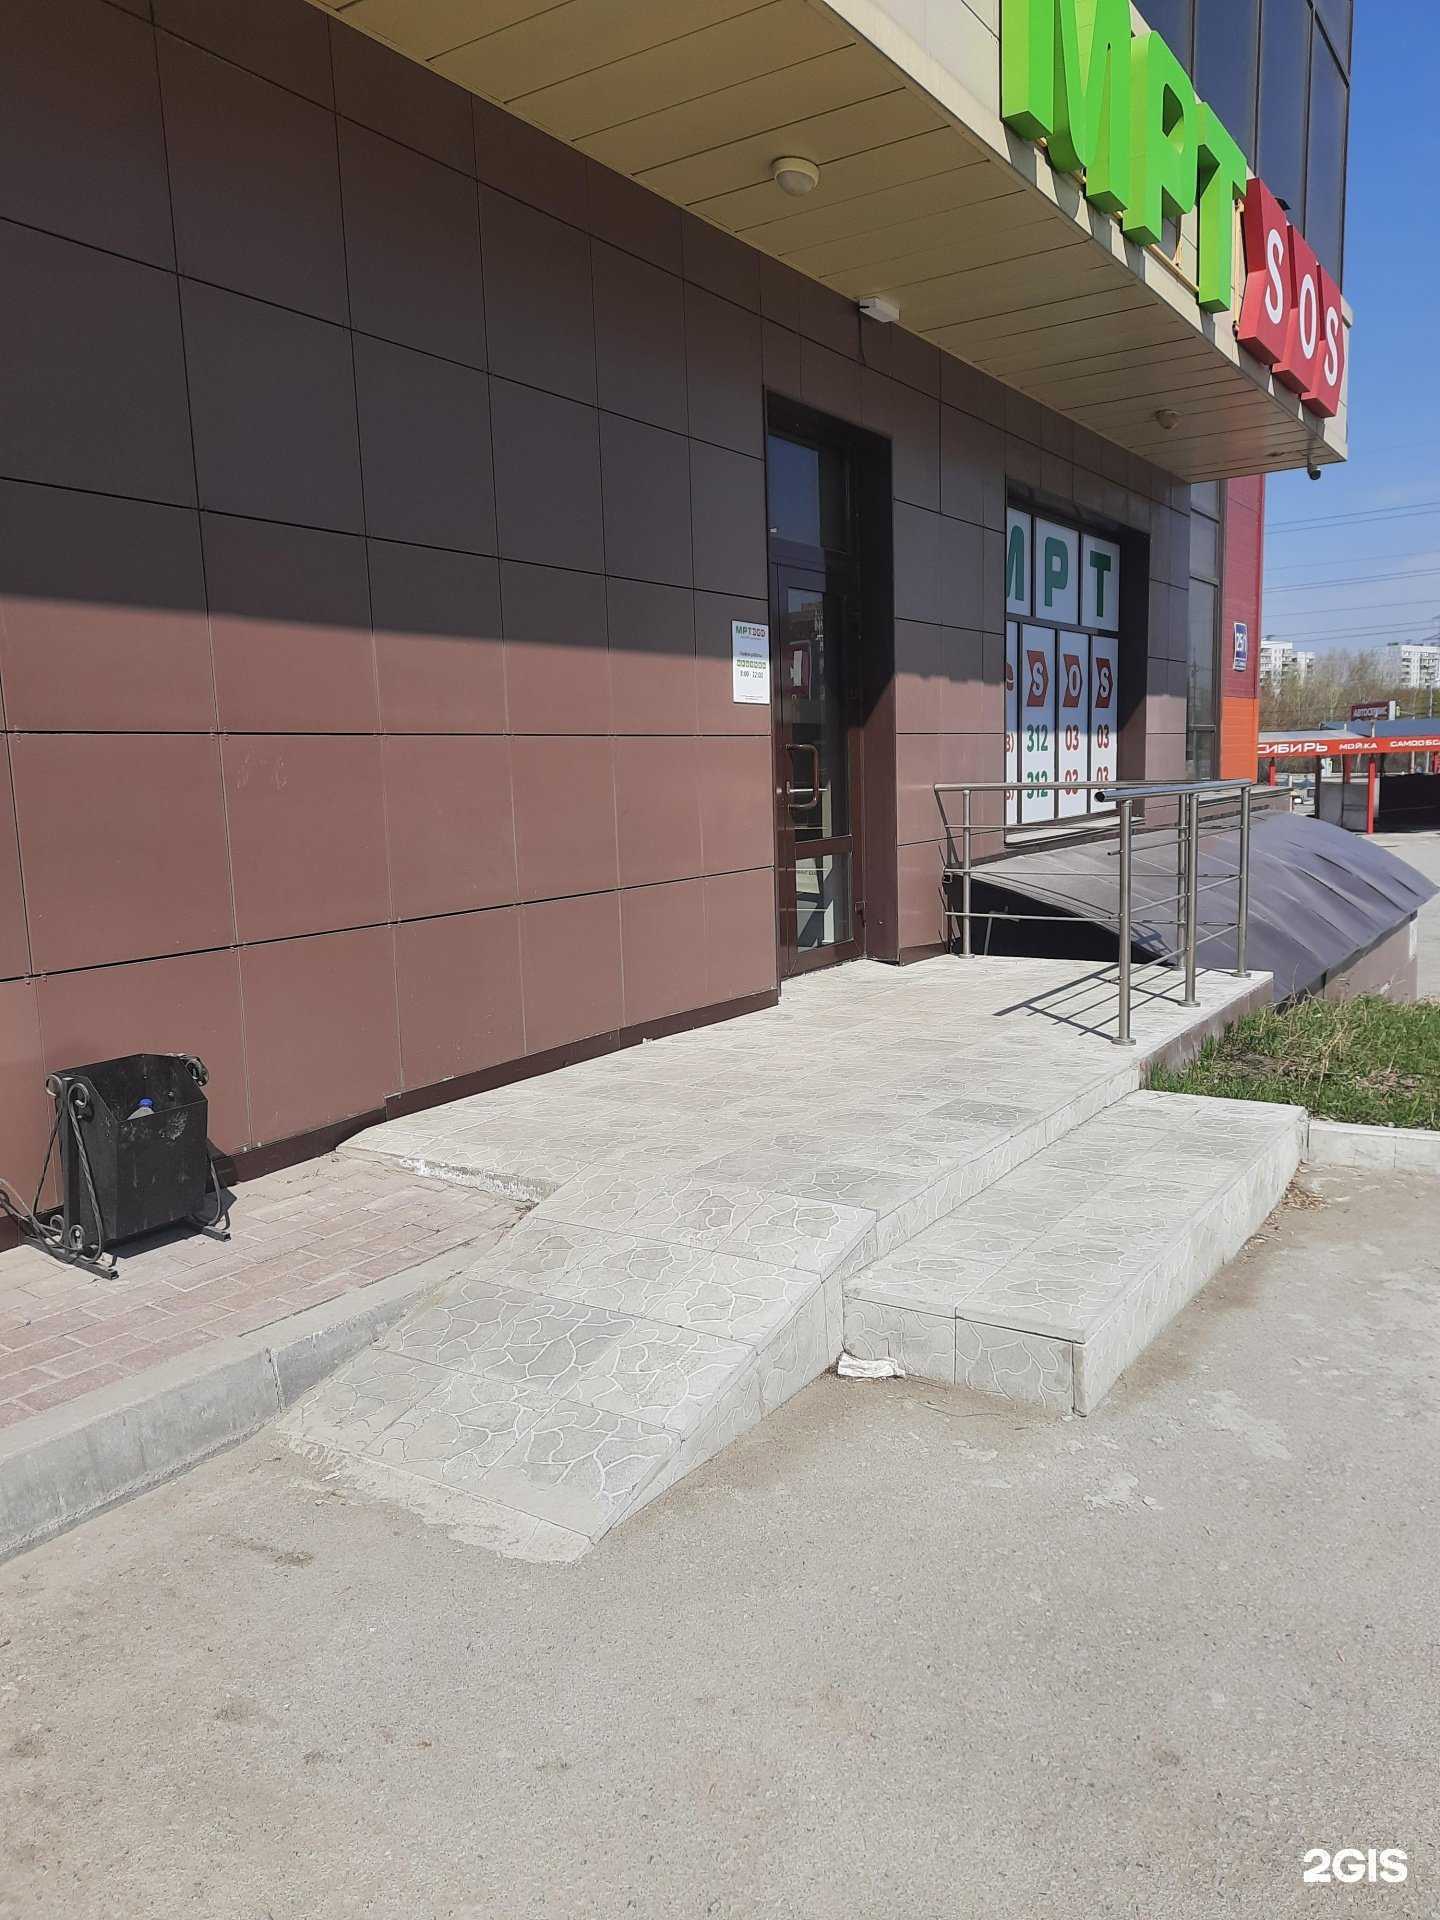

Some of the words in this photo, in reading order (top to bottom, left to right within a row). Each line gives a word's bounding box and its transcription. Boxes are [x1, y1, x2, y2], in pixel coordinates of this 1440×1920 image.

[1264, 229, 1339, 387] SOS
[1032, 661, 1110, 698] SOS
[1026, 723, 1049, 753] 312
[1065, 724, 1079, 751] 03
[1097, 724, 1110, 749] 03
[1339, 741, 1378, 750] МОЙКА
[1026, 770, 1048, 799] 312
